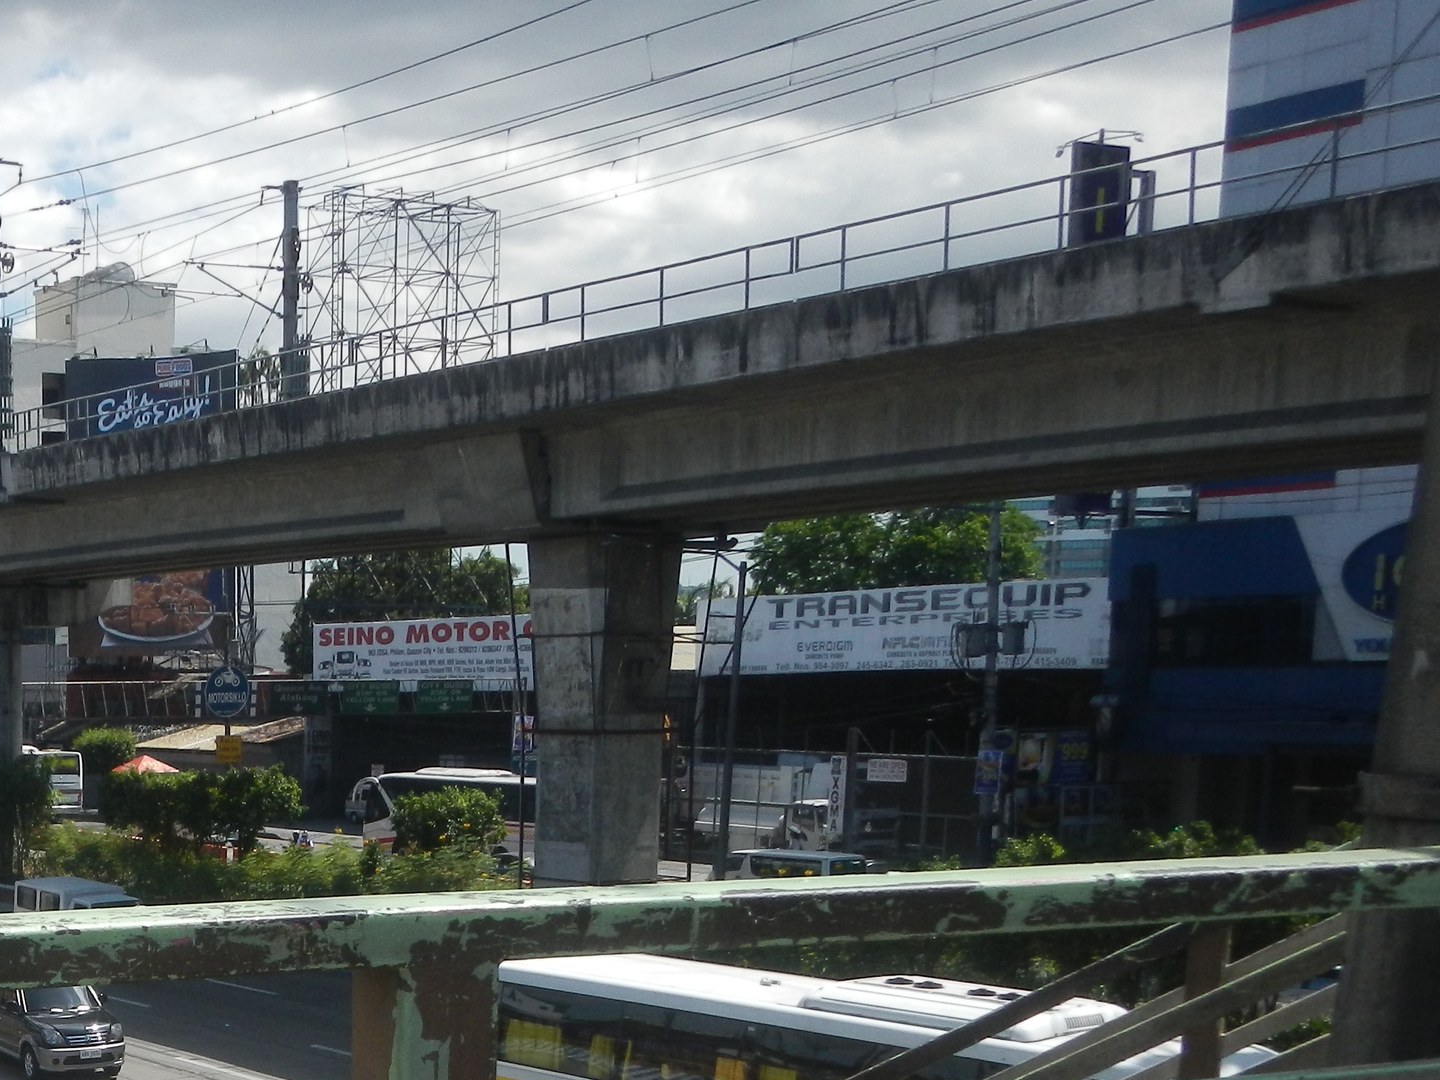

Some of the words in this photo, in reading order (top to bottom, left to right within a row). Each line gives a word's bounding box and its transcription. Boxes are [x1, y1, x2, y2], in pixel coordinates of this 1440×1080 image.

[318, 625, 396, 647] SEINO
[405, 620, 510, 645] MOTOR
[208, 692, 247, 703] MOTORSIKLO
[829, 776, 841, 832] XGMA
